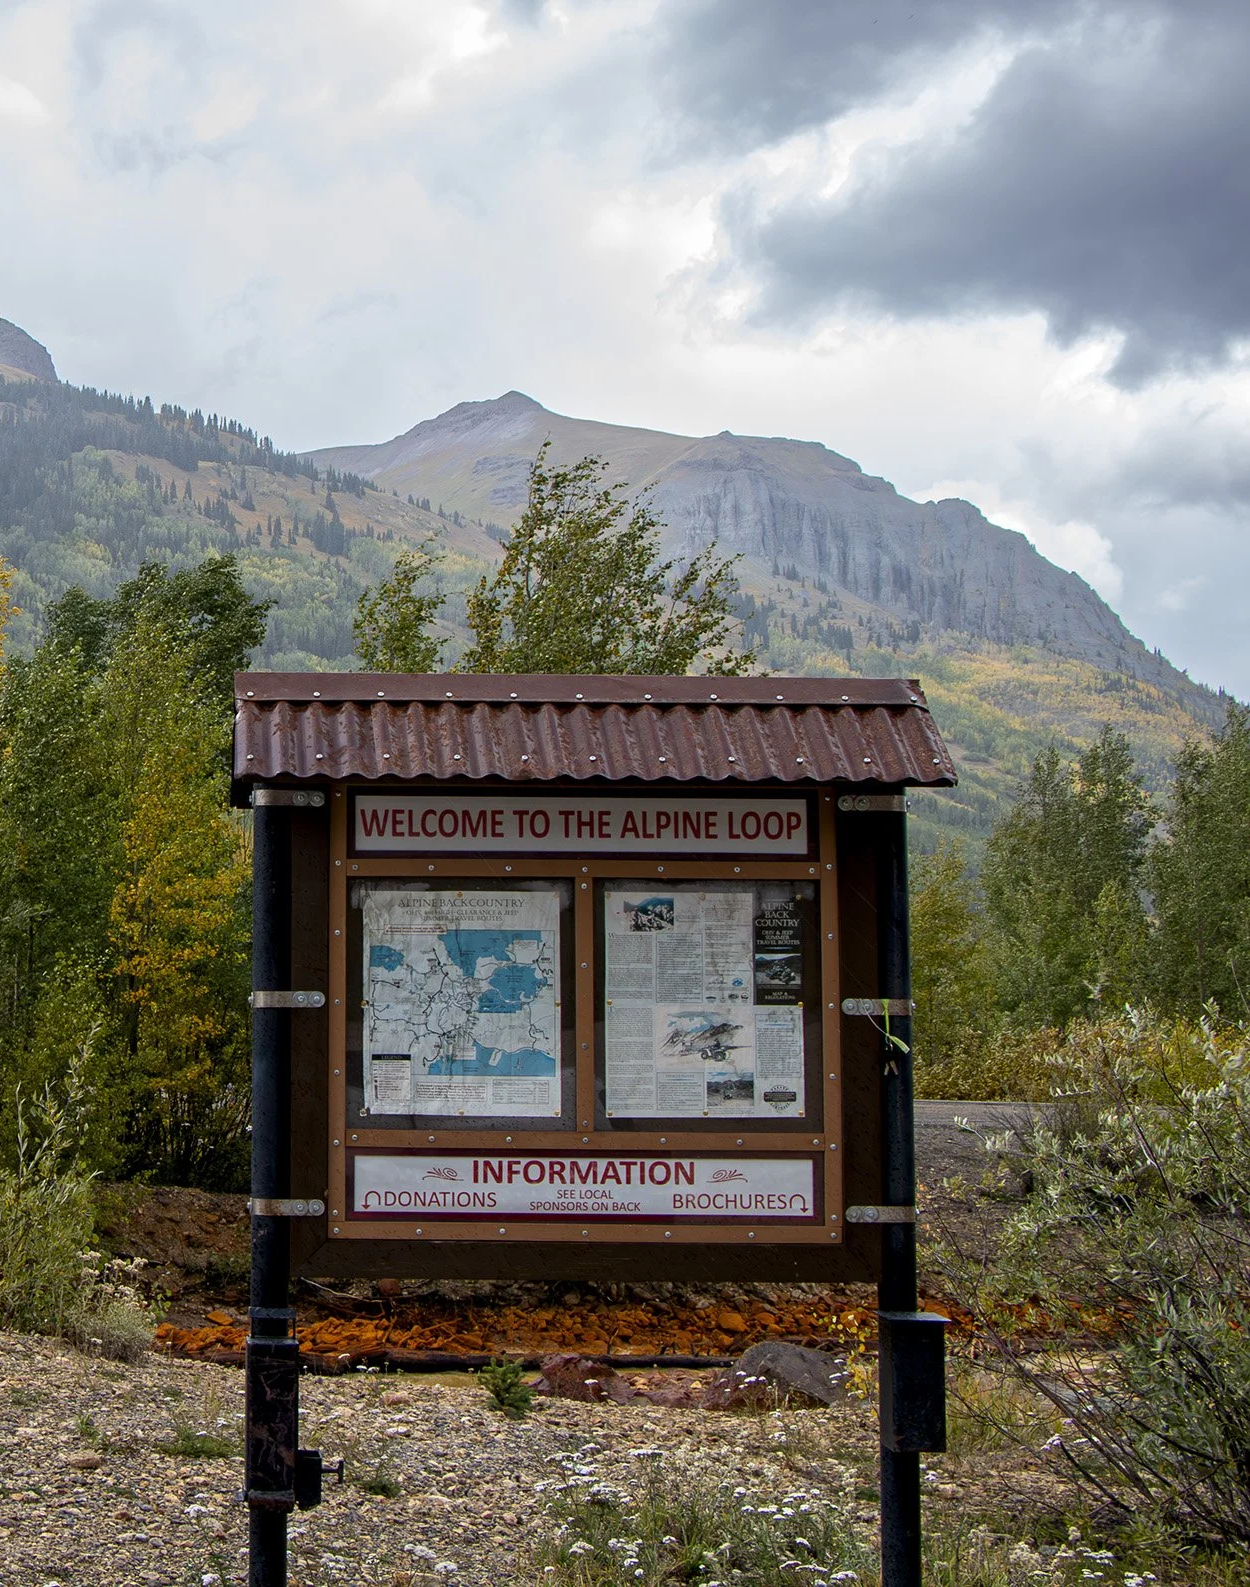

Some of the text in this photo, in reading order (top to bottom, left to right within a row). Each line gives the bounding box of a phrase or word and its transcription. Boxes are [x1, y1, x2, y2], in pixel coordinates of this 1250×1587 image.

[360, 808, 802, 840] WELCOME TO THE ALPINE LOOP
[398, 899, 437, 907] ALPINE
[755, 919, 799, 927] COUNTRY
[472, 1159, 695, 1186] INFORMATION
[384, 1191, 497, 1208] DONATIONS
[556, 1189, 614, 1200] SEE LOCAL
[672, 1193, 787, 1210] BROCHURES
[529, 1201, 641, 1212] SPONSORS ON BACK
